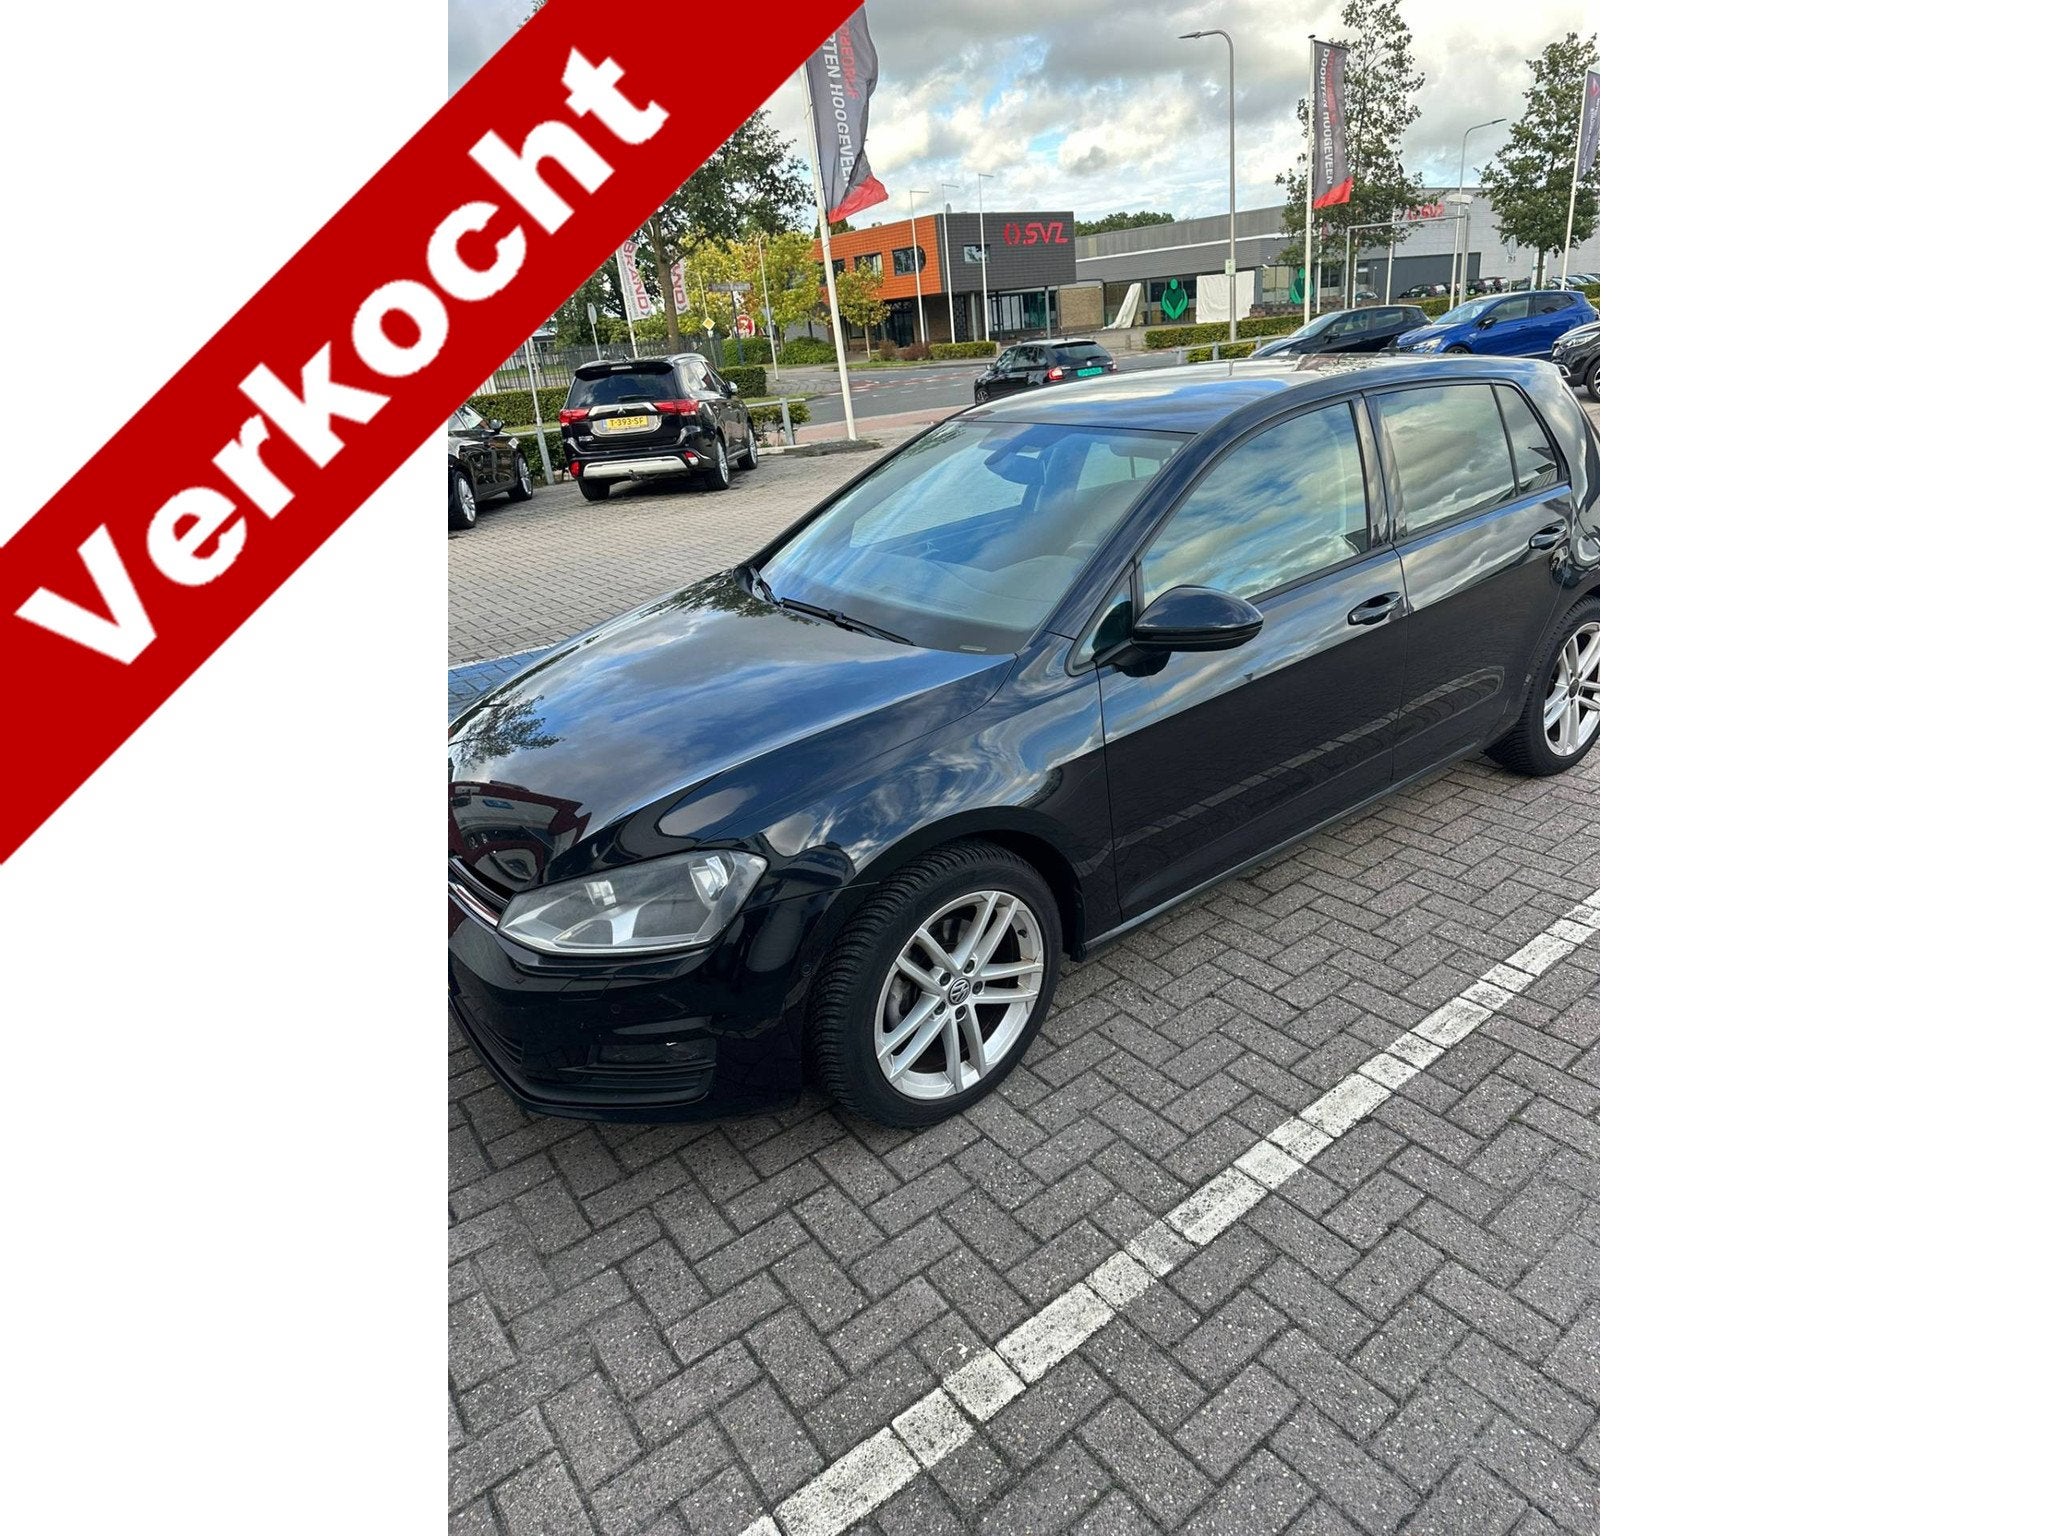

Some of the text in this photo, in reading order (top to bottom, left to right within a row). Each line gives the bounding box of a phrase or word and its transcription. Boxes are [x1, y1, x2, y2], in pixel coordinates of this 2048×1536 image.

[822, 33, 855, 184] RTEN HOOGEVEE
[1023, 222, 1069, 245] SVZ
[623, 241, 649, 309] BRAND
